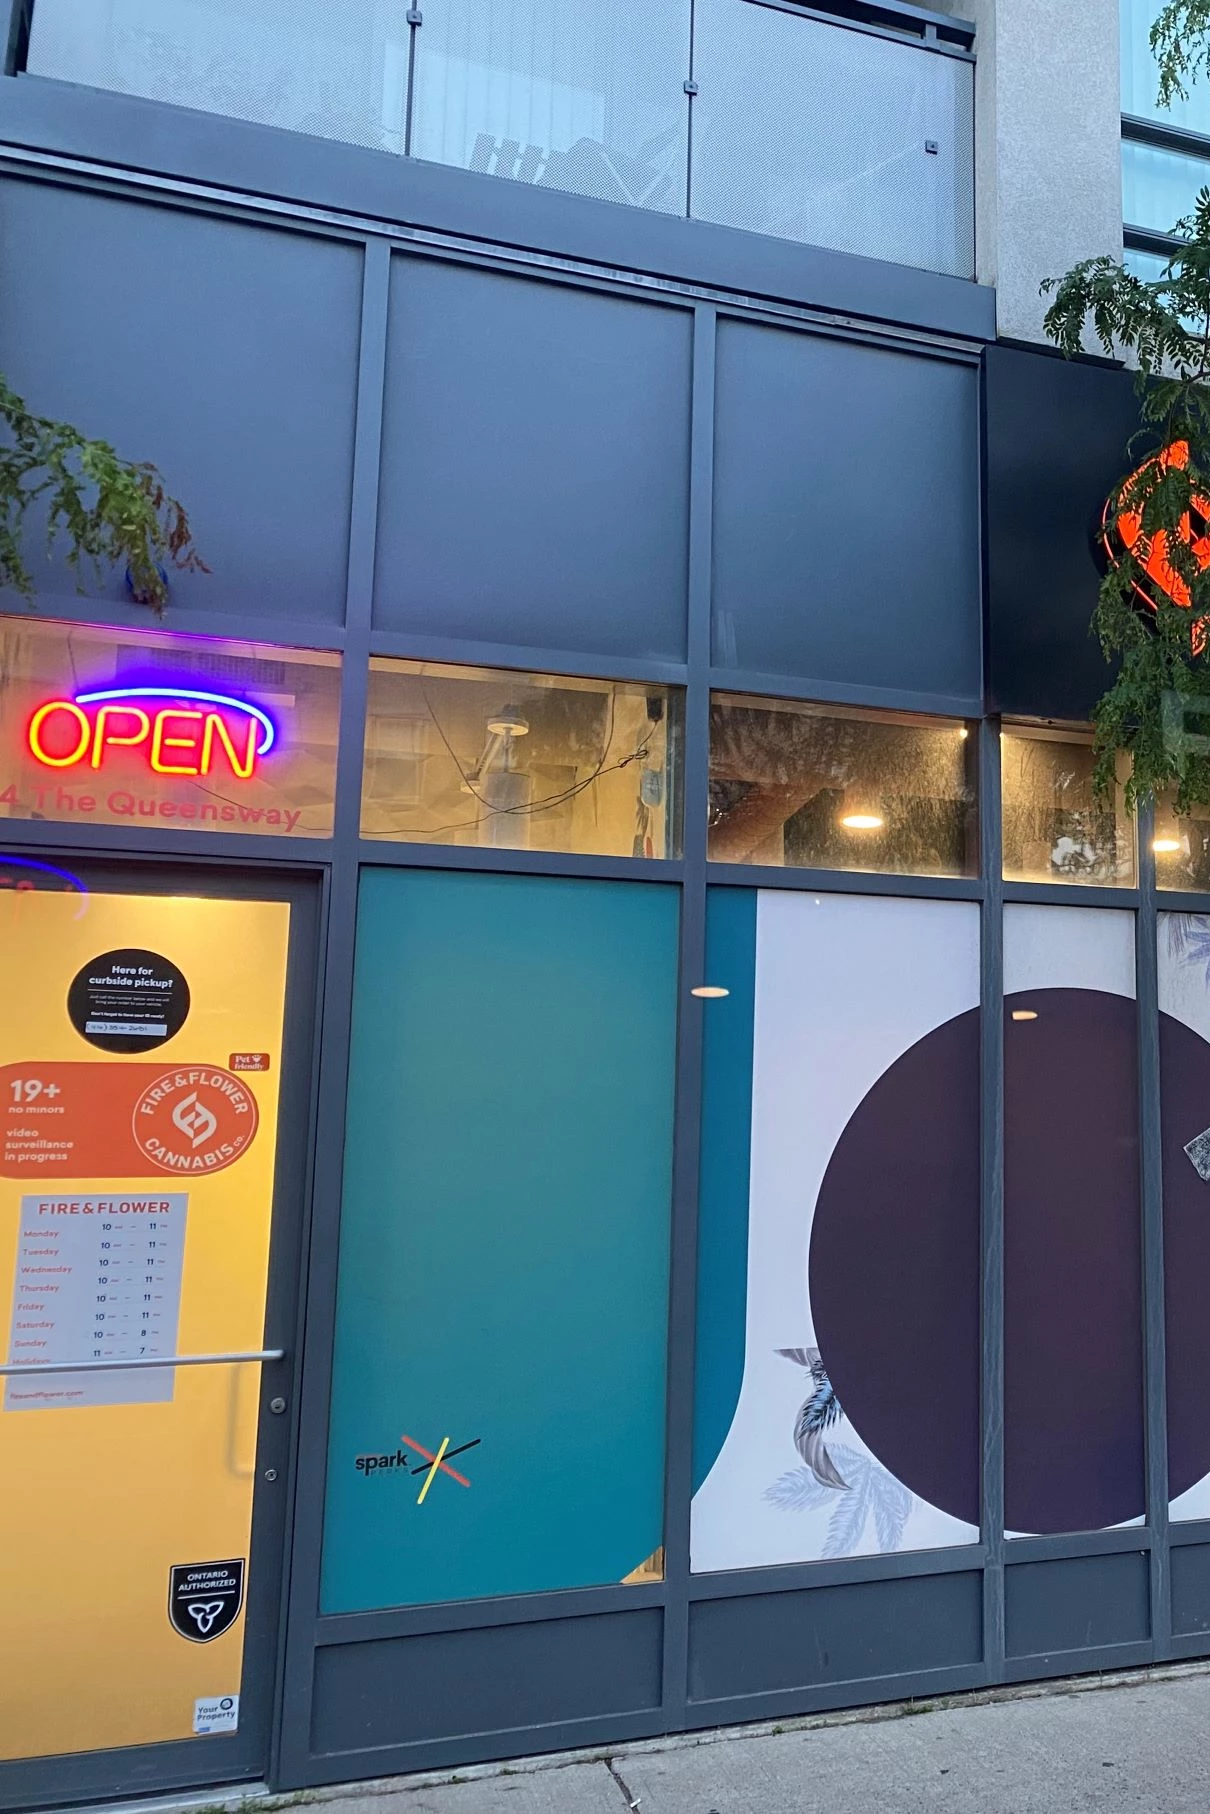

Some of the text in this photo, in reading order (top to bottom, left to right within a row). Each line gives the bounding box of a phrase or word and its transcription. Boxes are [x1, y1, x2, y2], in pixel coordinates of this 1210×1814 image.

[29, 701, 256, 778] OPEN
[32, 786, 97, 813] The
[107, 791, 301, 832] Queensway
[112, 966, 153, 975] Here for
[89, 977, 173, 989] curbside pickup?
[10, 1079, 61, 1102] 19+
[8, 1106, 65, 1114] no minors
[6, 1128, 39, 1137] video
[5, 1140, 74, 1149] surveillance
[4, 1152, 68, 1163] in progress
[145, 1138, 234, 1169] CANNABIS
[23, 1248, 59, 1256] Tuesday
[21, 1266, 72, 1274] Wednesday
[18, 1303, 45, 1311] Friday
[139, 1347, 145, 1355] 7
[356, 1450, 408, 1476] spark
[187, 1570, 228, 1582] ONTARIO
[178, 1578, 236, 1592] AUTHORIZED
[198, 1706, 218, 1714] Your
[198, 1712, 235, 1721] Property
